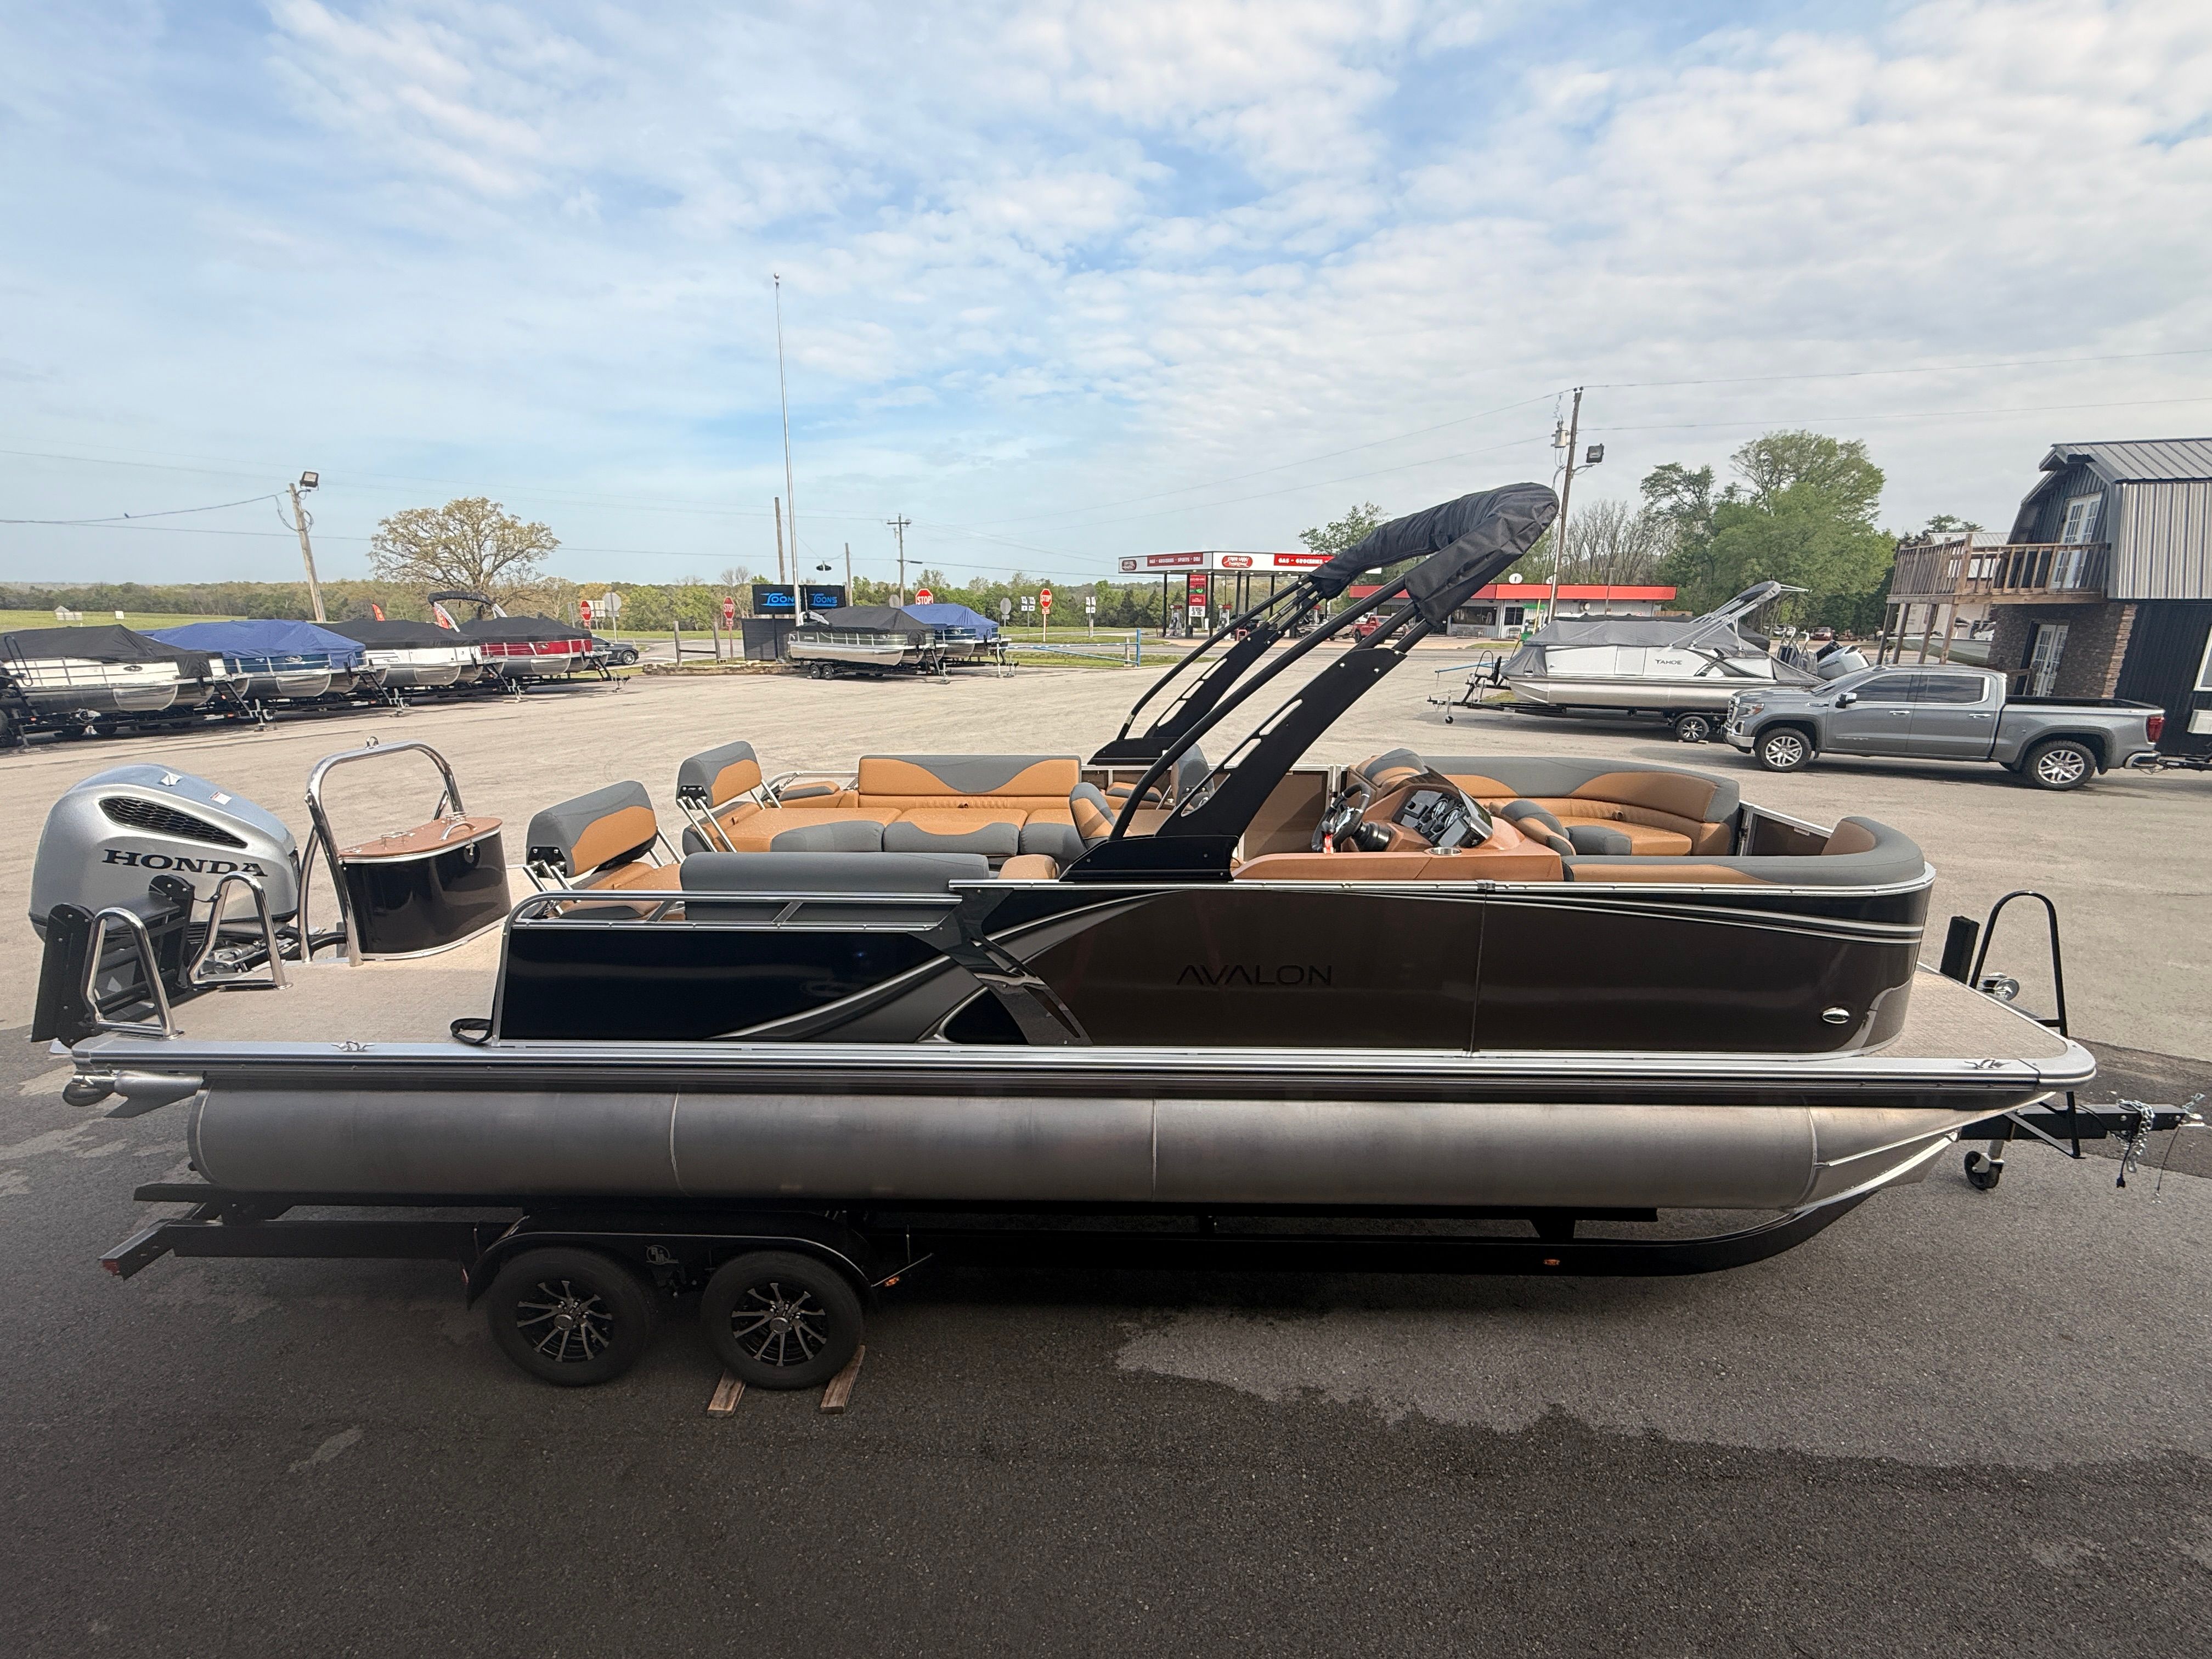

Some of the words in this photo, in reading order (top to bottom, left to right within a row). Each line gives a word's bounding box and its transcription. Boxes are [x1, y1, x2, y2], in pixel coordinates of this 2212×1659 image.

[810, 593, 838, 607] TOONS
[917, 595, 932, 605] STOP
[724, 603, 734, 613] STOP
[101, 849, 269, 877] HONDA
[1176, 964, 1333, 986] AVALON
